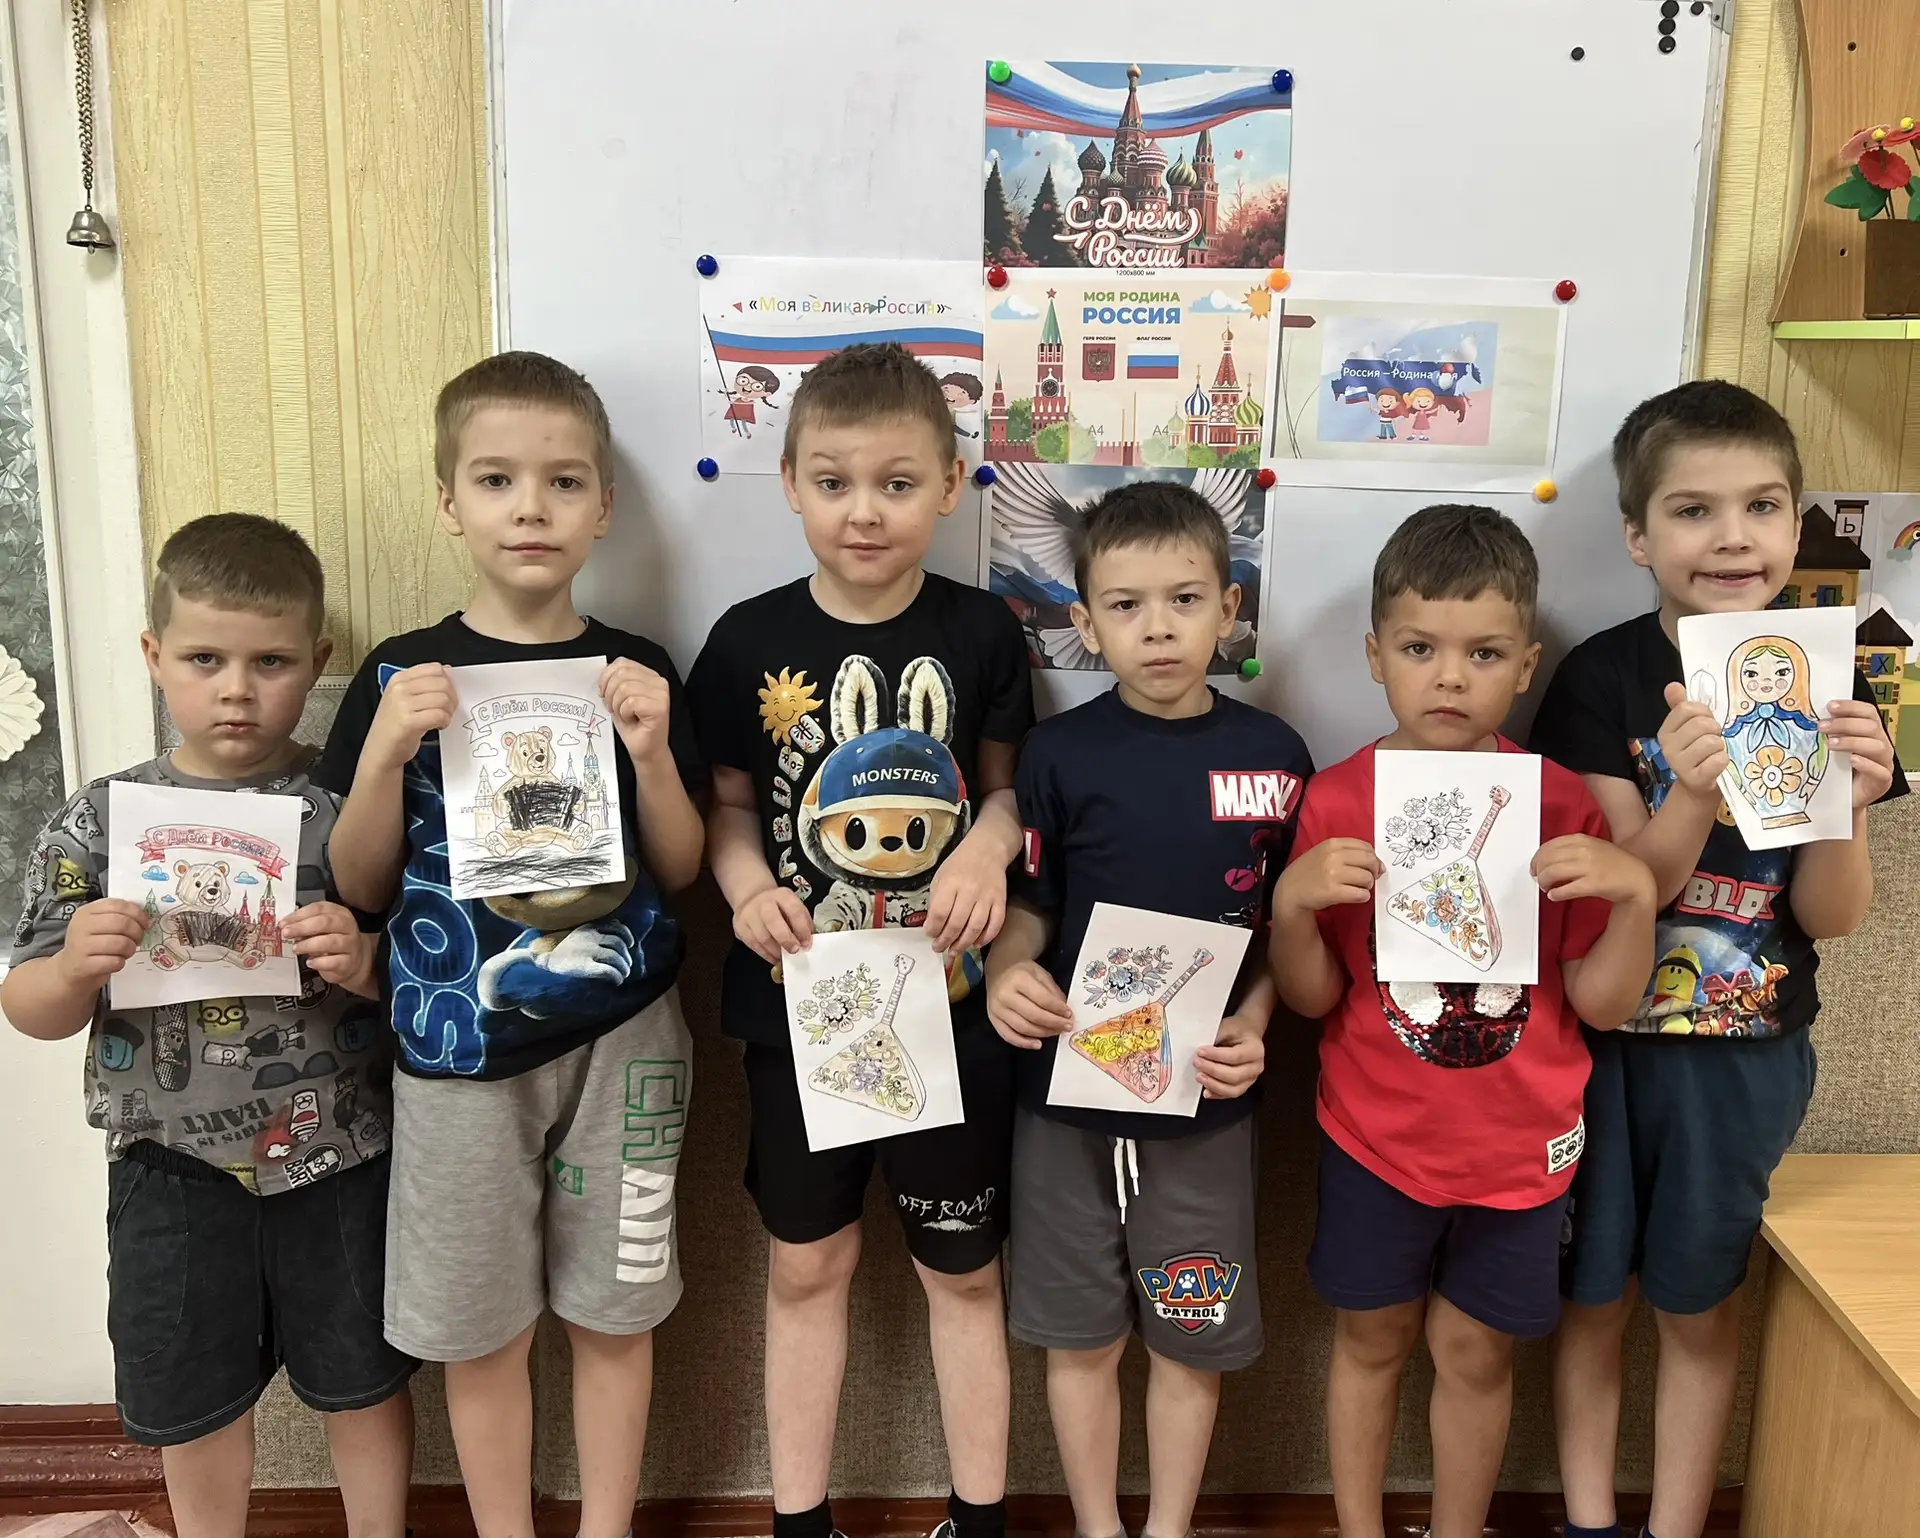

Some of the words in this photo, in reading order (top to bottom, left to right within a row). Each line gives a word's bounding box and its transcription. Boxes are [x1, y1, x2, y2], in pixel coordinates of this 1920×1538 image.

[1065, 196, 1094, 230] С
[1095, 196, 1202, 235] Днём
[1086, 231, 1185, 267] России
[749, 296, 796, 313] «Моя
[802, 299, 869, 314] великая
[877, 298, 945, 315] Россия»
[1083, 291, 1115, 302] МОЯ
[1119, 291, 1181, 304] РОДИНА
[1082, 306, 1181, 324] РОССИЯ
[1342, 367, 1380, 378] Россия
[1392, 368, 1433, 380] Родина
[478, 707, 490, 721] С
[492, 700, 529, 720] Днём
[532, 698, 589, 718] России!
[852, 768, 940, 787] MONSTERS
[152, 830, 165, 845] С
[168, 829, 208, 845] Днём
[181, 1098, 273, 1135] BART
[284, 1158, 313, 1189] BART
[899, 1194, 934, 1217] OFF
[937, 1187, 995, 1220] ROAD
[1137, 1262, 1242, 1301] PAW
[1162, 1307, 1219, 1318] PATROL
